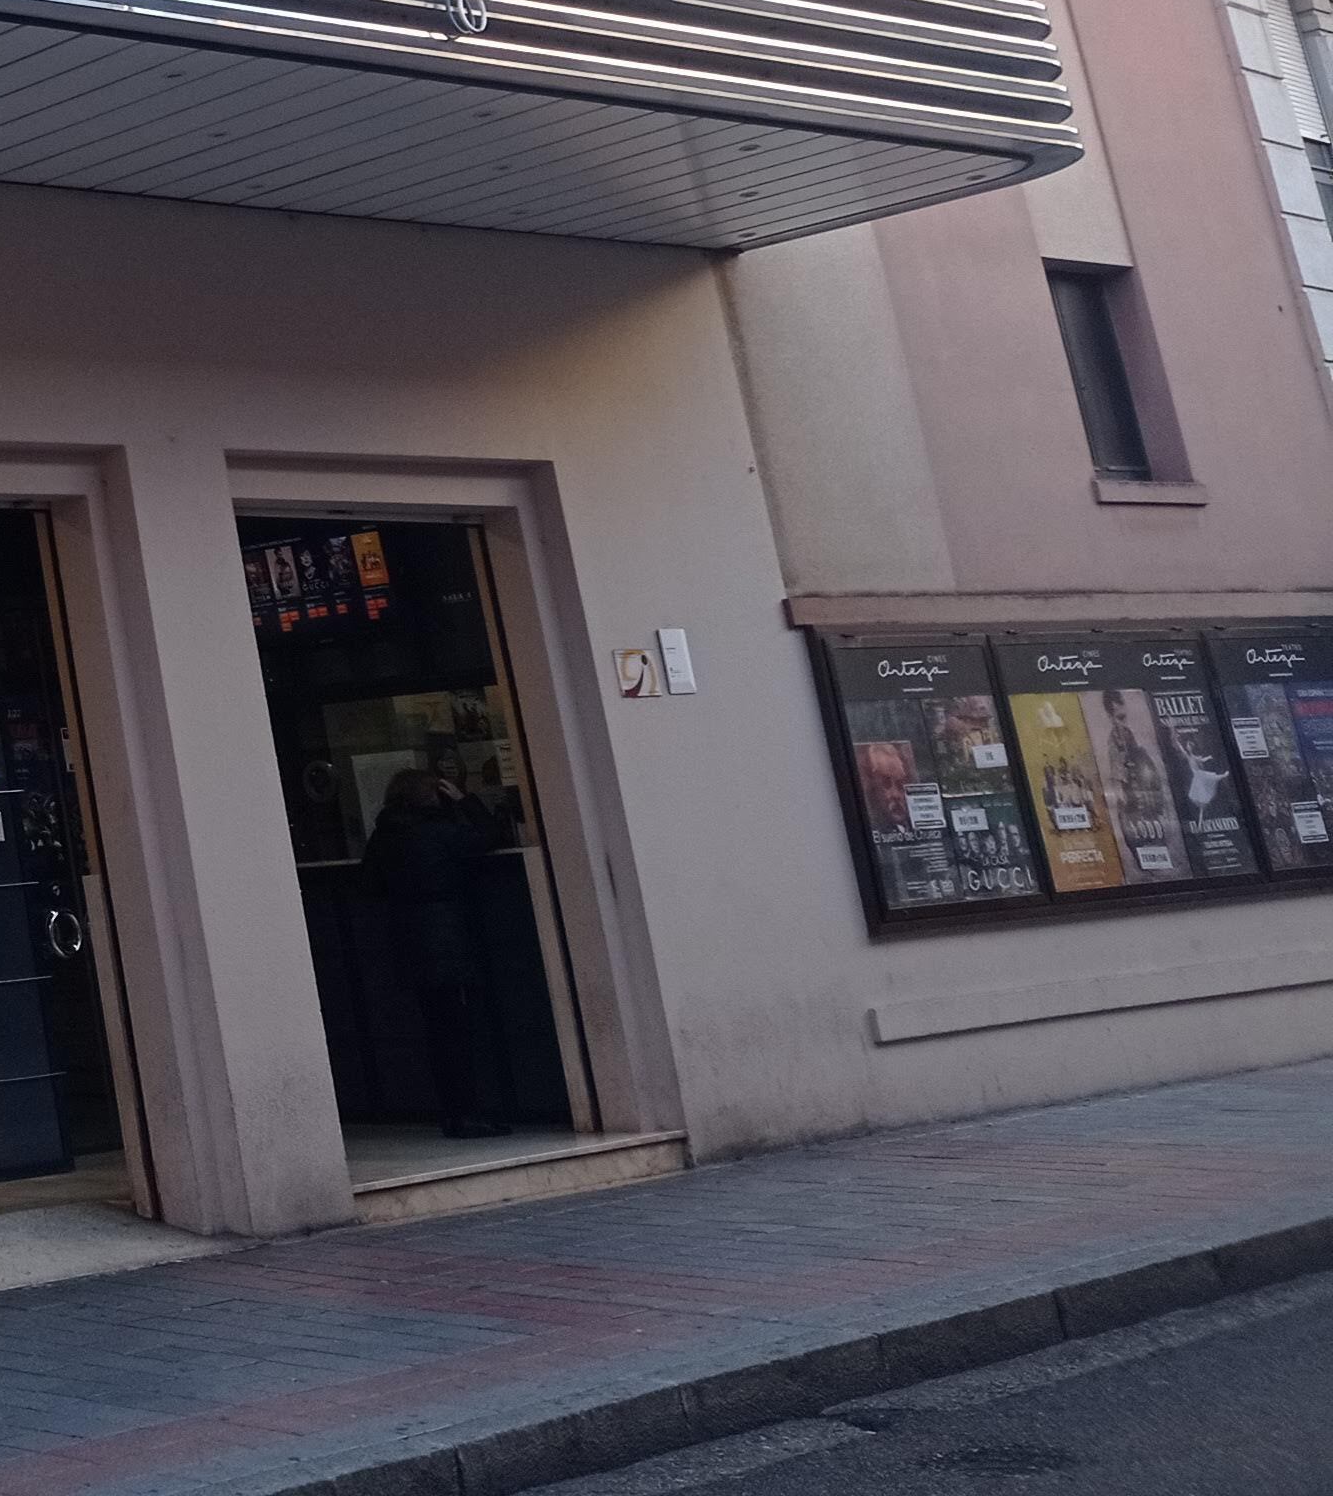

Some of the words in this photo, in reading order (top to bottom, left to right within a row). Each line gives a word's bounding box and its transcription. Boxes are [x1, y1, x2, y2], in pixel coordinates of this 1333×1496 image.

[1037, 654, 1103, 676] Ortega
[1142, 653, 1195, 671] Ortega
[1246, 648, 1306, 669] Ortega
[877, 659, 950, 682] Ortega
[1152, 694, 1206, 717] BALLET
[967, 864, 1033, 892] GUCCI
